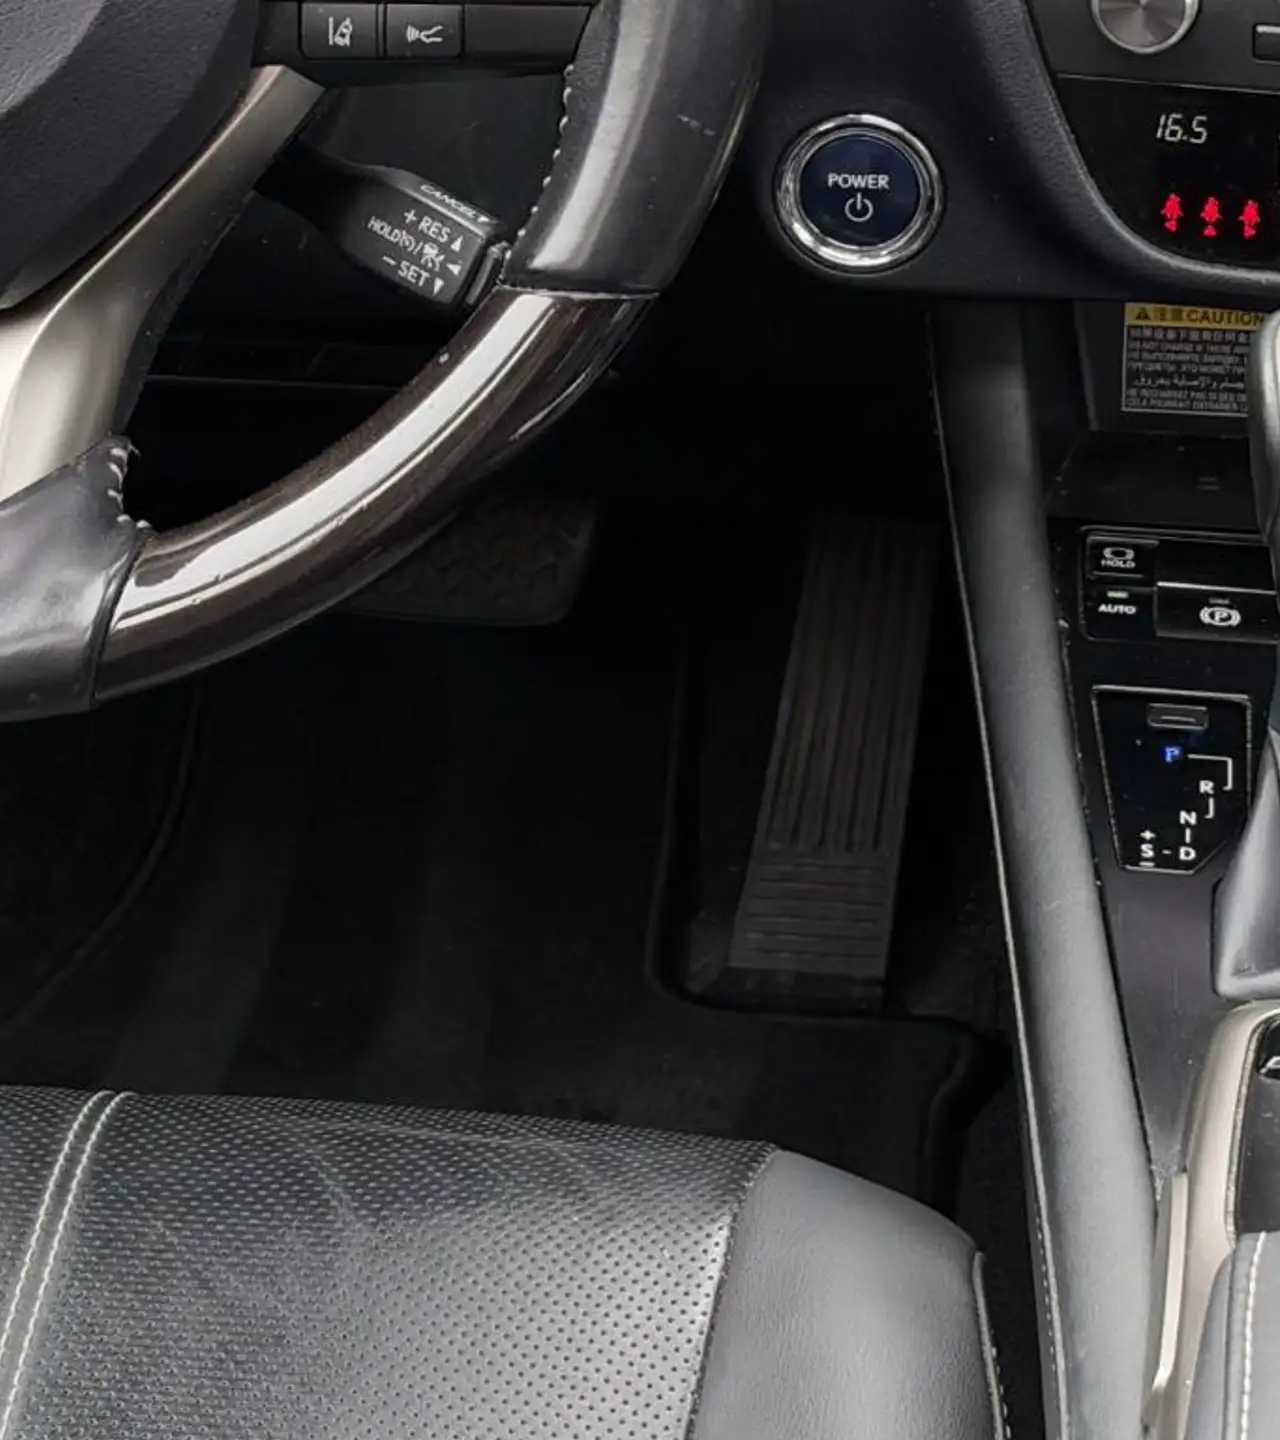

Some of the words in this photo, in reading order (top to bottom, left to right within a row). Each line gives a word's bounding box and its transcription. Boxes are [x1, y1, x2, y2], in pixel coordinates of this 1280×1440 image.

[1155, 114, 1208, 145] 16.5
[827, 172, 890, 189] POWER
[1186, 308, 1266, 326] CAUTION
[1101, 559, 1136, 569] HOLD
[1098, 604, 1137, 615] AUTO
[1165, 746, 1180, 762] P
[1199, 780, 1215, 795] R
[1180, 810, 1197, 825] N
[1140, 843, 1155, 859] S
[1179, 846, 1197, 861] D
